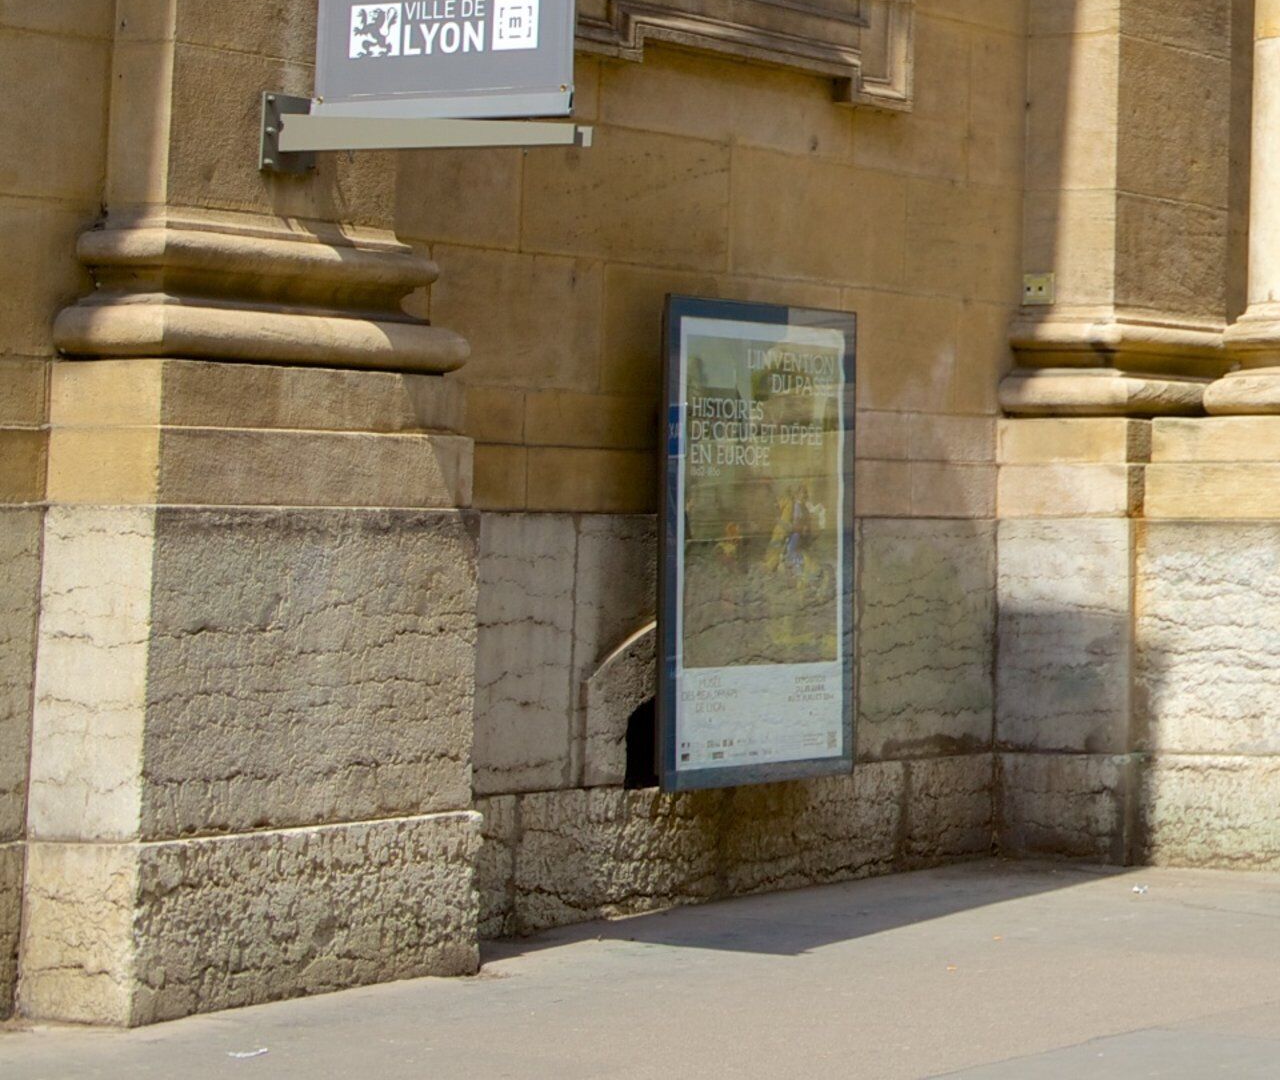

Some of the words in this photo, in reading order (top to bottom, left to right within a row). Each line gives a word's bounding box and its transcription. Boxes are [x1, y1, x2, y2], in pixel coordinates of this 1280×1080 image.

[403, 20, 486, 56] LYON
[771, 373, 792, 394] DU
[691, 397, 764, 420] HISTOIRES
[691, 421, 709, 441] DE
[760, 424, 777, 444] ET
[690, 444, 712, 465] EN
[716, 445, 771, 466] EUROPE
